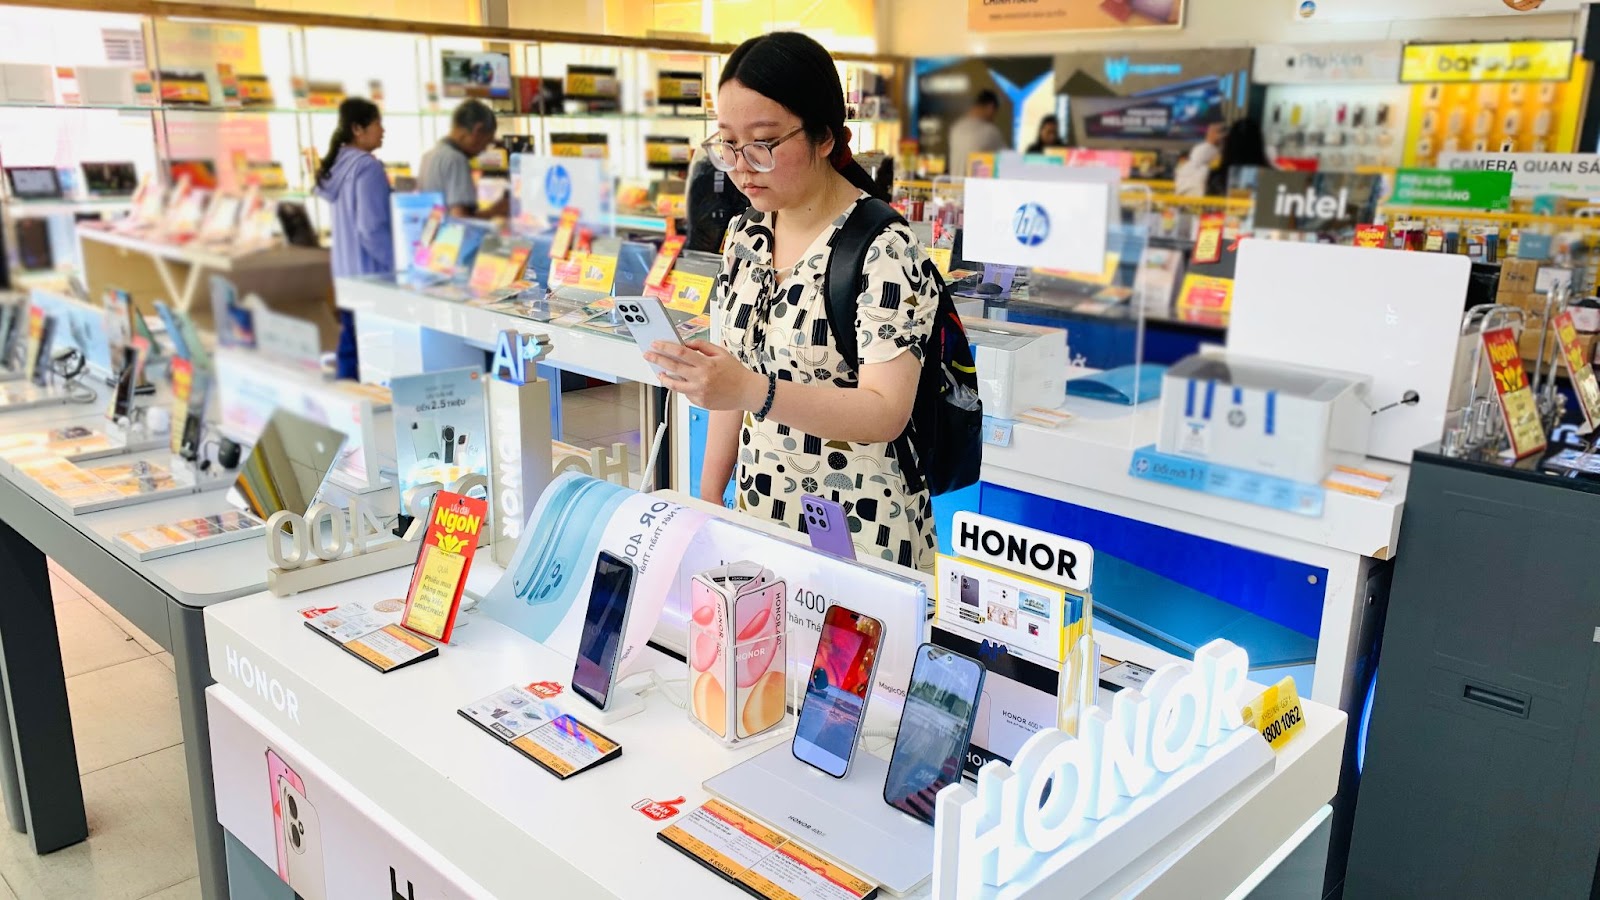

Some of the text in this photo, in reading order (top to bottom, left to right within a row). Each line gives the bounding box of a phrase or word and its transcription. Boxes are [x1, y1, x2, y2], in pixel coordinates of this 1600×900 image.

[1523, 159, 1573, 174] QUAN
[1274, 184, 1349, 220] intel
[431, 399, 447, 410] 2.5
[434, 506, 480, 535] NgoN
[960, 521, 1077, 581] HONOR
[795, 588, 826, 614] 400
[226, 644, 301, 725] HONOR
[878, 681, 907, 698] MagicOS
[1002, 709, 1027, 725] HONOR
[1262, 705, 1301, 744] 1800 1062
[932, 637, 1249, 900] HONOR
[787, 814, 812, 830] HONOR
